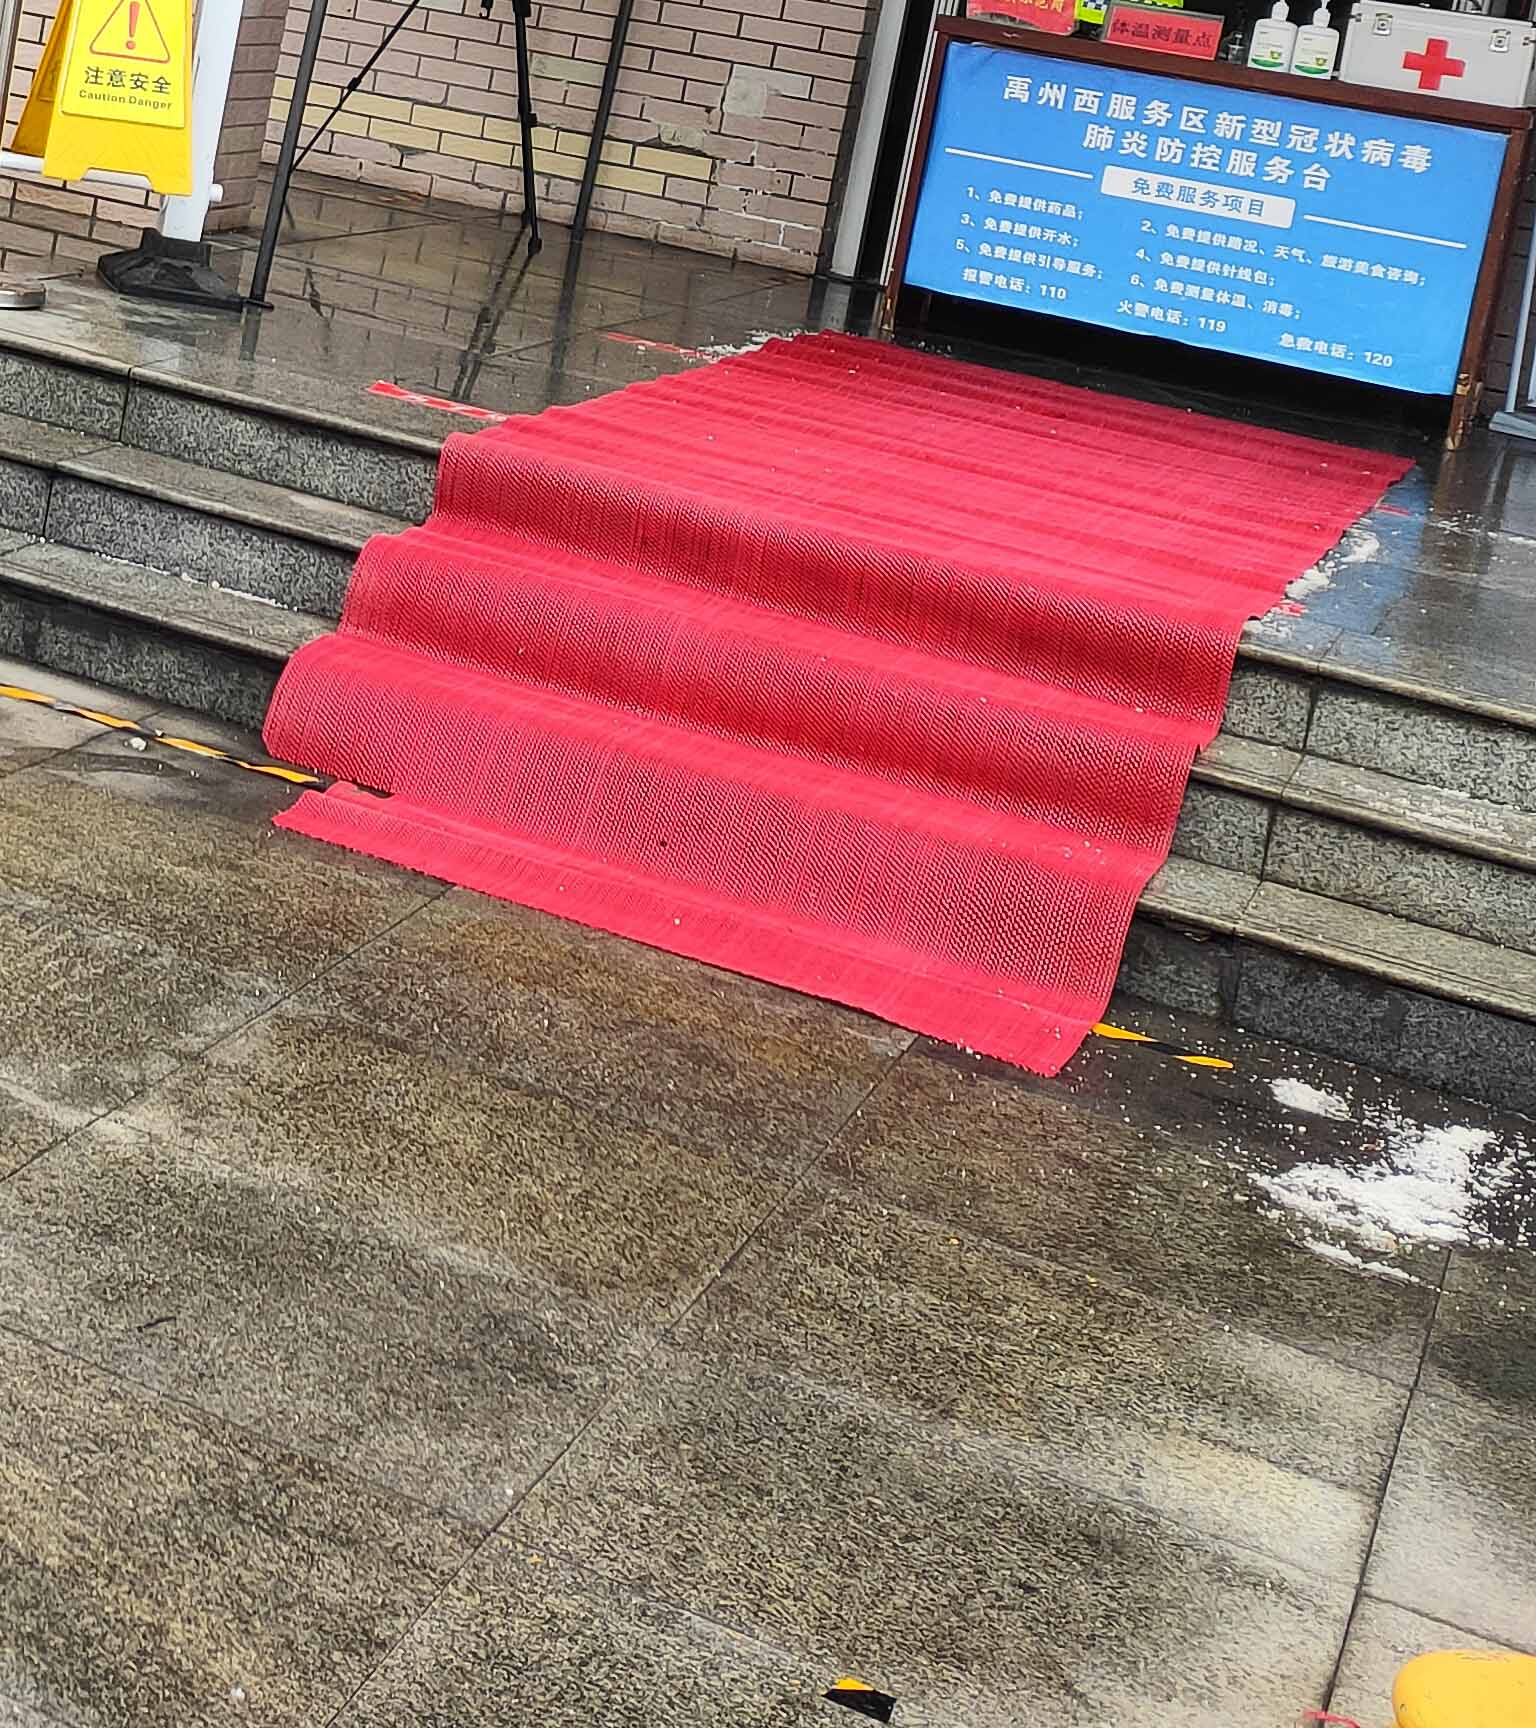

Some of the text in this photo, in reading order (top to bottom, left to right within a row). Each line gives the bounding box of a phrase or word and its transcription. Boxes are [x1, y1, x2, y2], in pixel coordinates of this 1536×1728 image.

[1111, 18, 1214, 48] 体温测量点
[84, 64, 172, 95] 注意安全
[79, 88, 173, 111] Caution Danger
[1003, 75, 1434, 174] 禹州西服务区新型冠状病毒
[1082, 123, 1333, 192] 肺炎防控服务台
[1131, 177, 1265, 217] 免费服务项目
